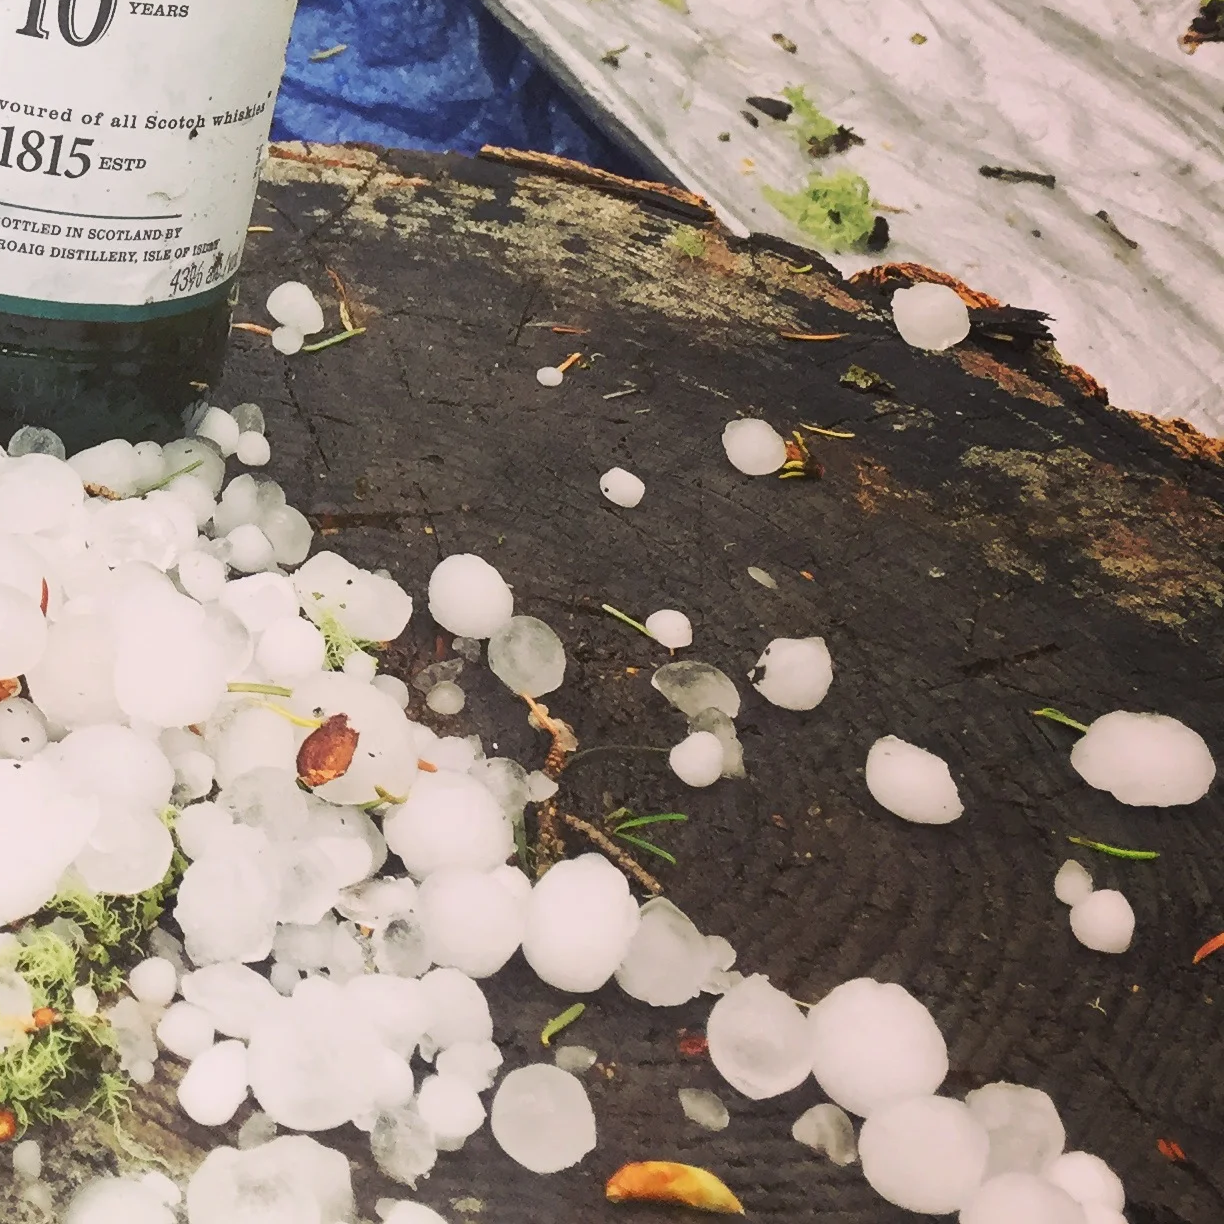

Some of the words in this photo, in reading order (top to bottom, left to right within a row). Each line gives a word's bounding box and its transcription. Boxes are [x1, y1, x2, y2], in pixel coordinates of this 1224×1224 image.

[129, 1, 190, 18] YEARS
[81, 112, 104, 126] of
[110, 114, 137, 129] all
[144, 114, 206, 130] Scotch
[212, 102, 266, 127] whiskies
[98, 156, 147, 172] ESTD
[65, 226, 84, 239] IN
[87, 227, 163, 242] SCOTLAND
[165, 227, 183, 240] BY
[49, 246, 139, 264] DISTILLERY,
[142, 249, 171, 263] ISLE
[174, 246, 190, 260] OF
